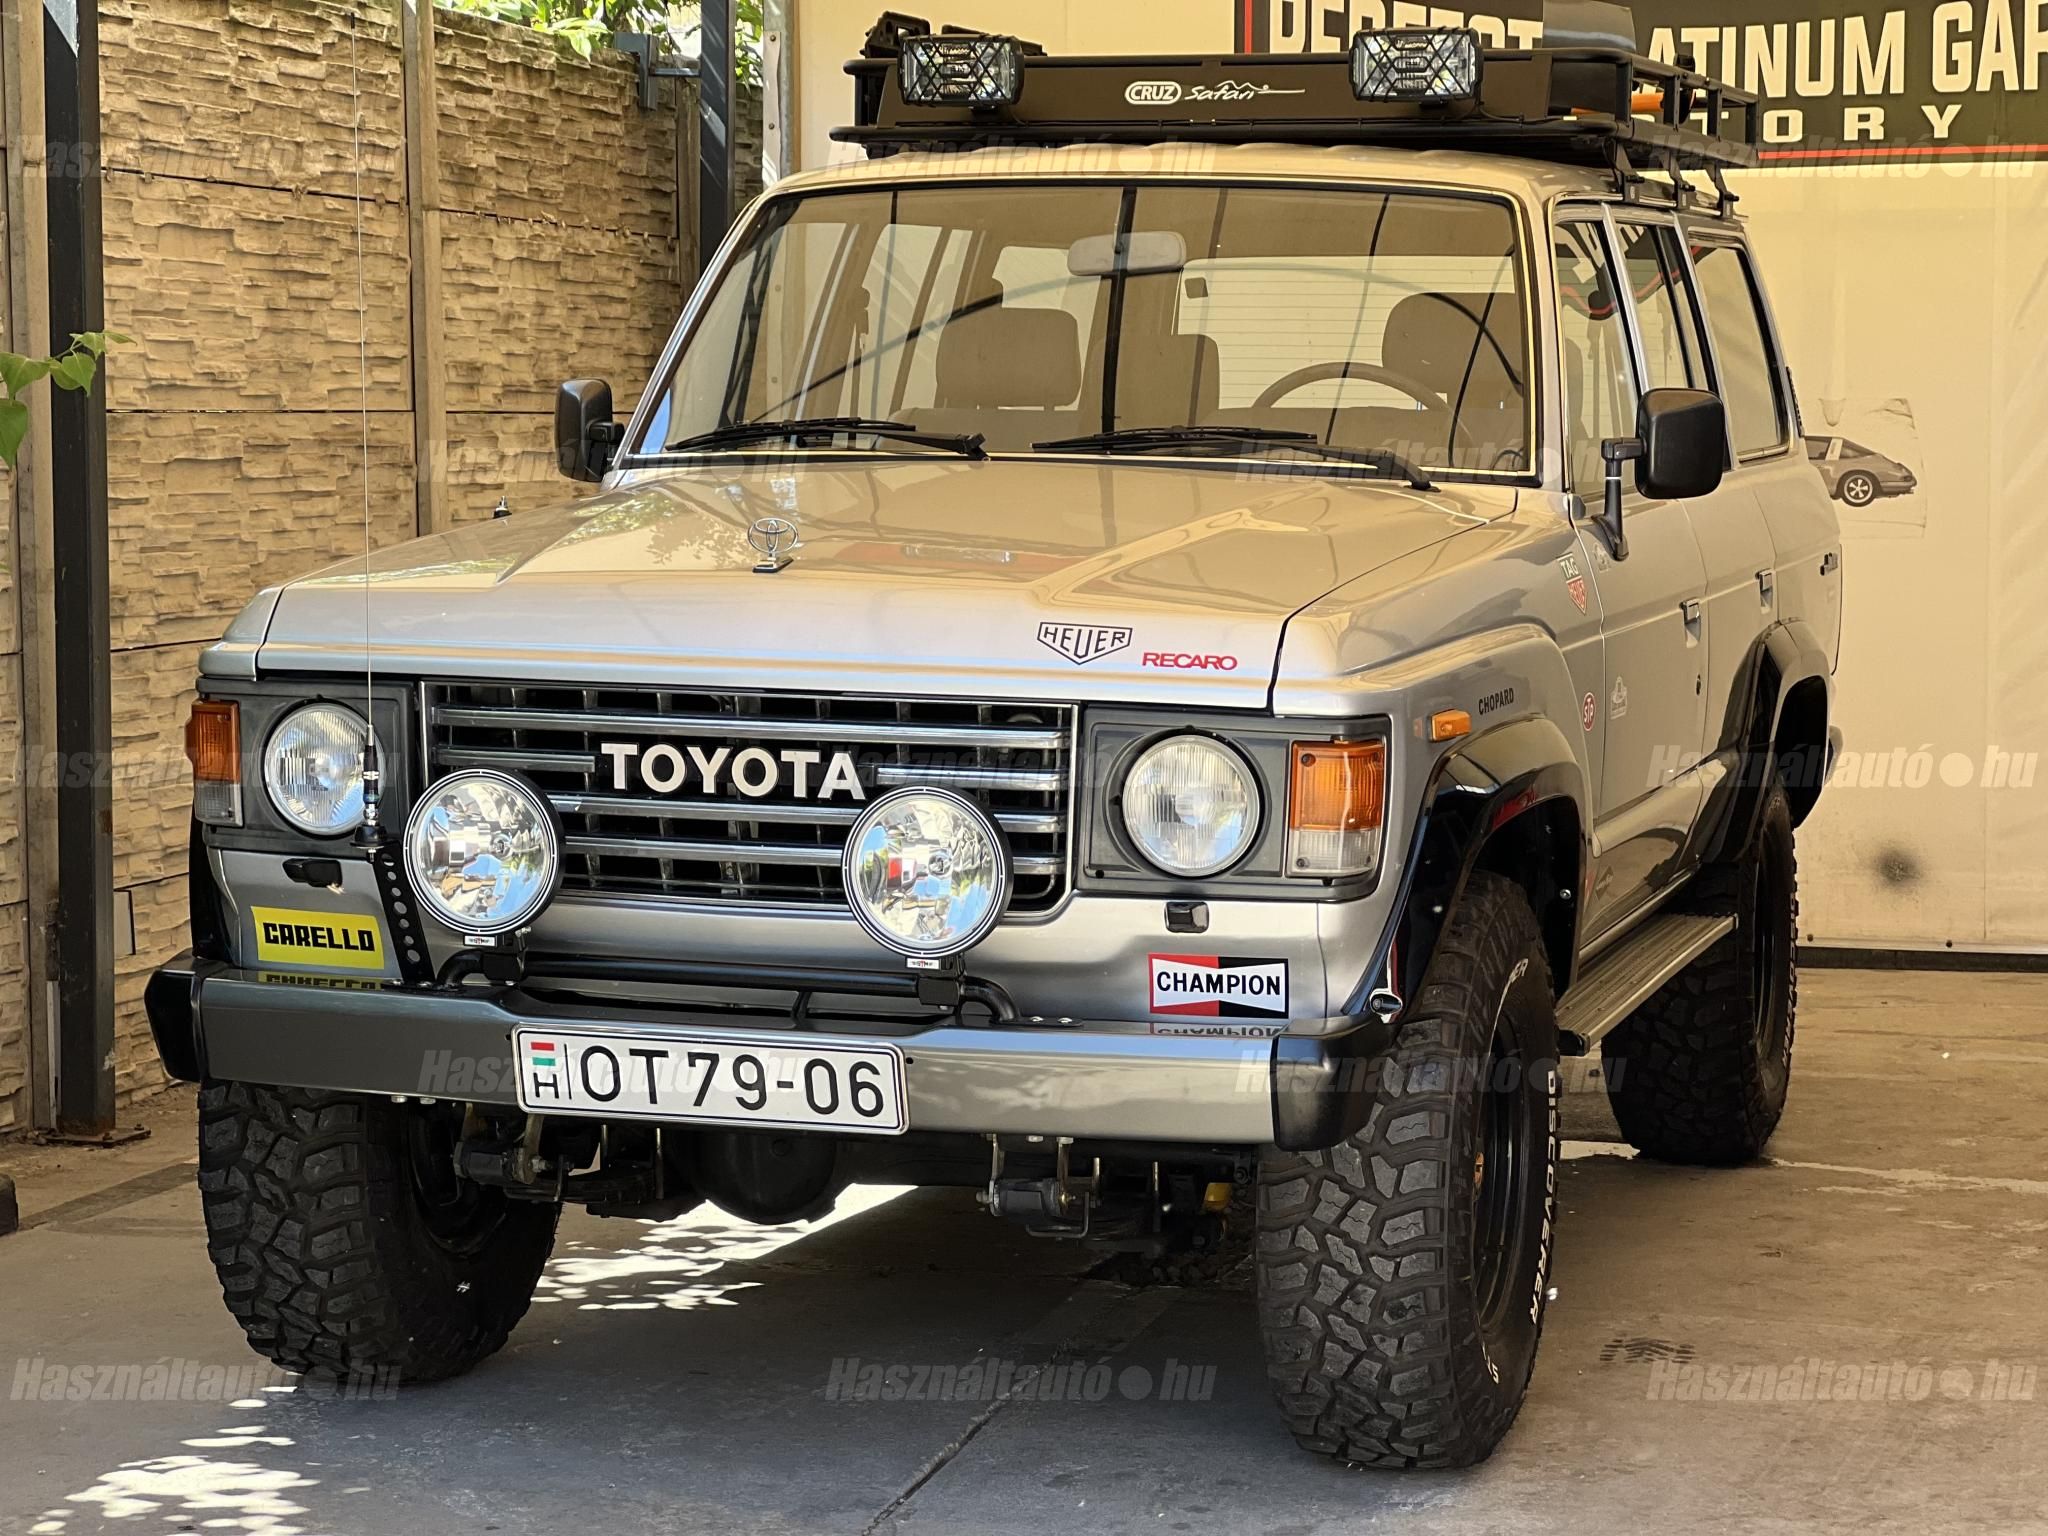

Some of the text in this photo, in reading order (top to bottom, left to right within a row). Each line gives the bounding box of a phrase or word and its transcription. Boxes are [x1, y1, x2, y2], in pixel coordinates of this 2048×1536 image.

[1130, 85, 1255, 101] CRUZ Safari
[1560, 558, 1579, 579] TAG
[1043, 626, 1126, 659] HEUER
[1142, 652, 1238, 671] RECARO
[1478, 687, 1514, 716] CHOPARD
[1584, 697, 1594, 723] STP
[601, 743, 866, 800] TOYOTA
[262, 922, 376, 952] CARELLO
[1157, 971, 1281, 996] CHAMPION
[533, 1072, 560, 1100] H
[1530, 1070, 1556, 1325] DISCOVERER
